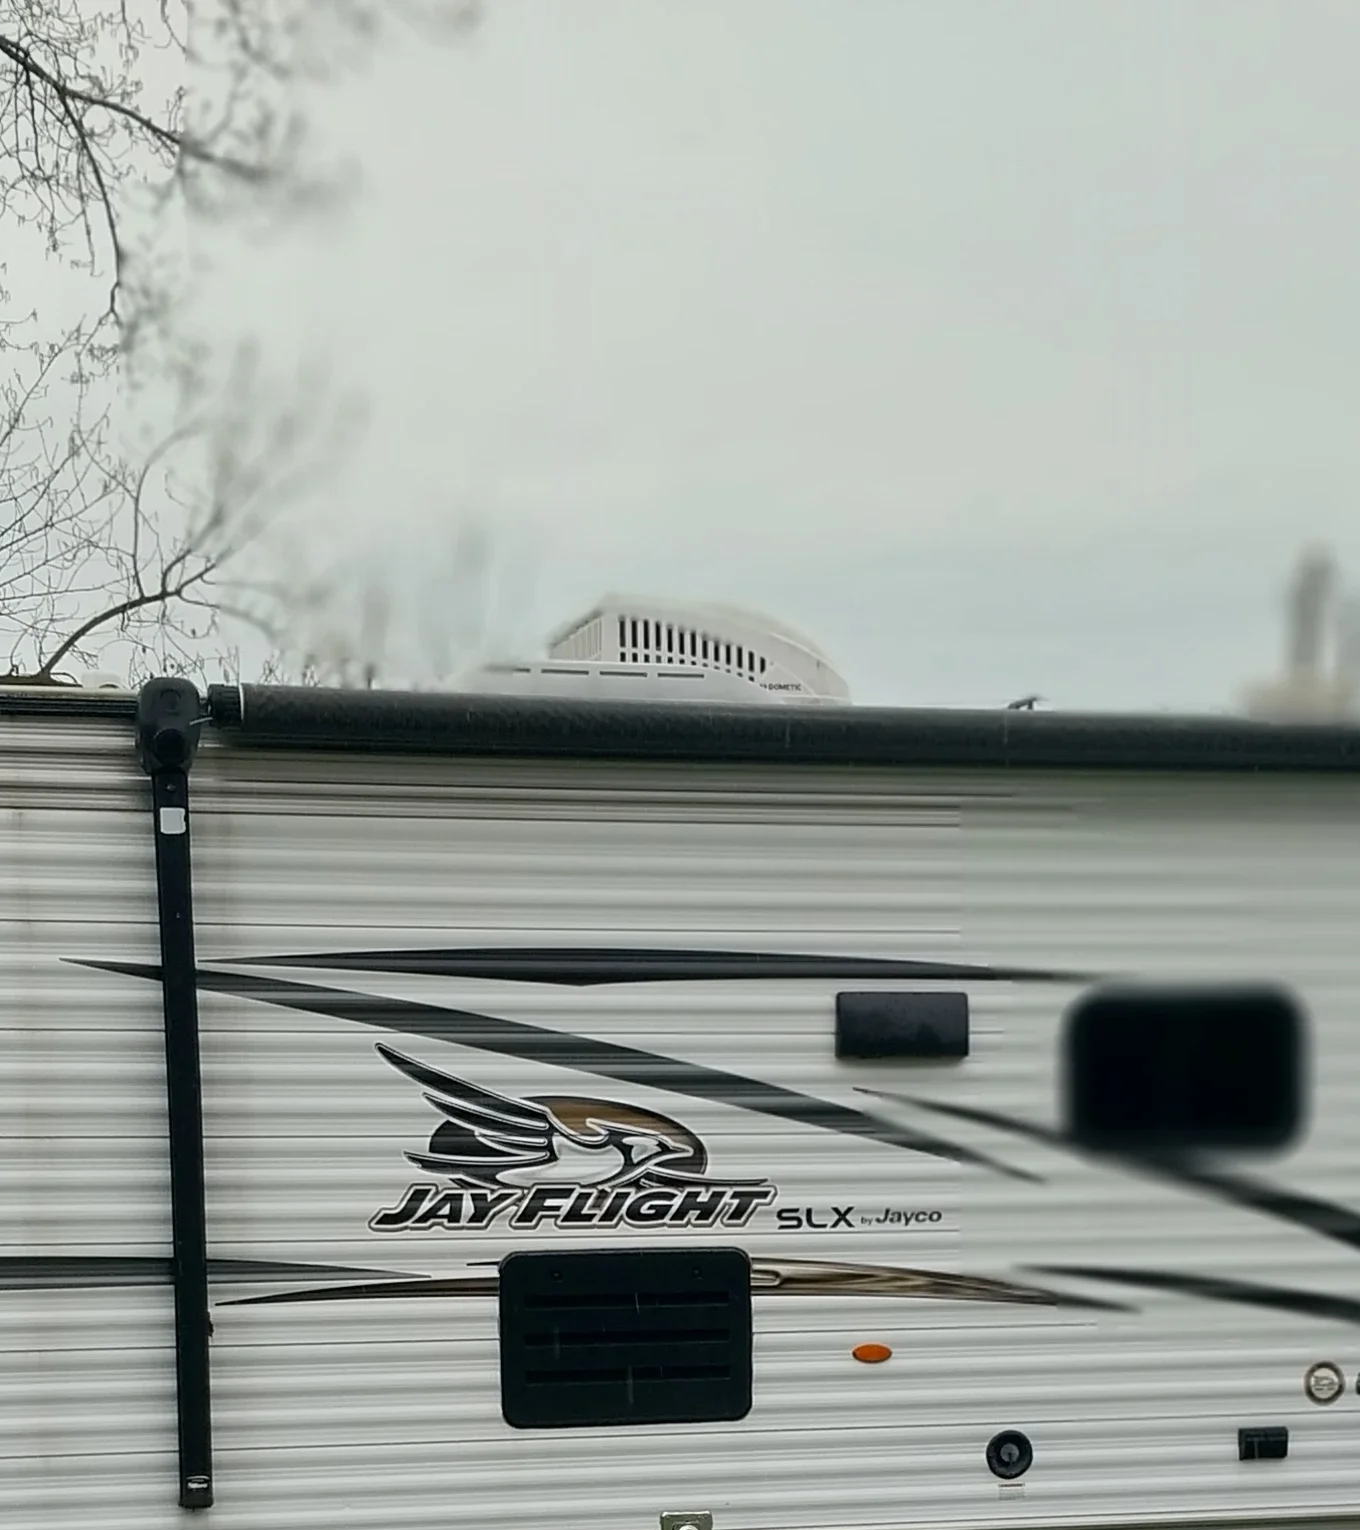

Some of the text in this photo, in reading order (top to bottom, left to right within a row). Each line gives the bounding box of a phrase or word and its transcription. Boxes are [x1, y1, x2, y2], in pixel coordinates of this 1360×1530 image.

[370, 1183, 942, 1230] JAY FLIGHT SLX by Jayco
